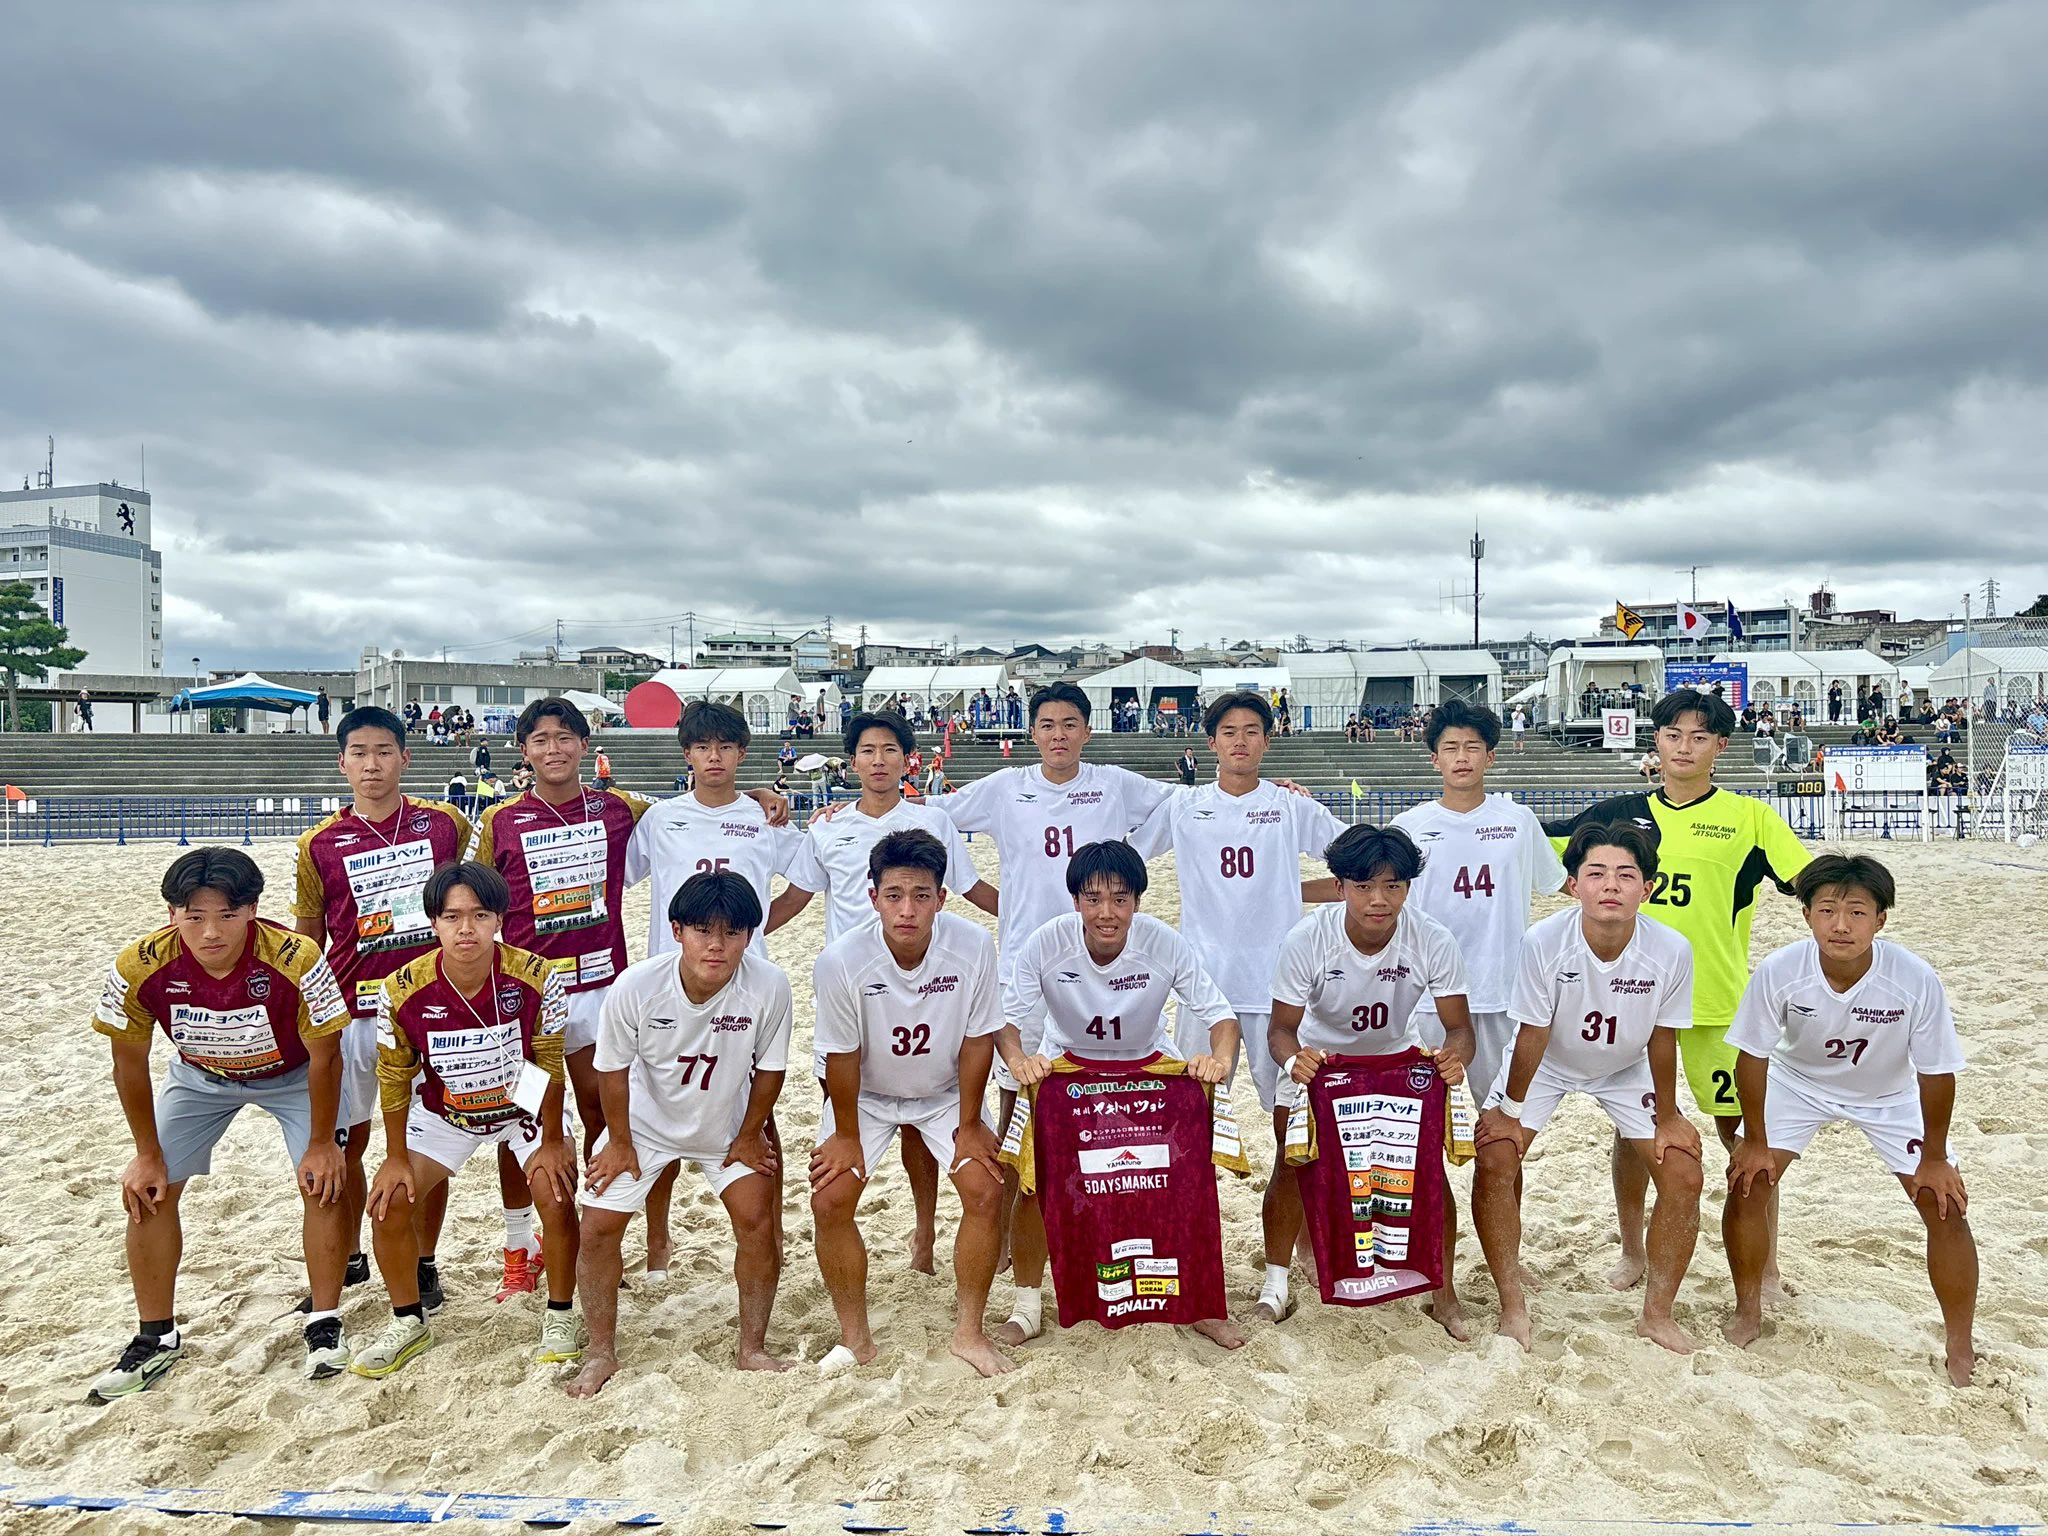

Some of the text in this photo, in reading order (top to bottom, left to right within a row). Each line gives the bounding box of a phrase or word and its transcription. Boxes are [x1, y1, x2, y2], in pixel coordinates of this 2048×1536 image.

[49, 508, 100, 533] HOTEL
[1855, 764, 1863, 776] 0
[1855, 778, 1863, 789] 0
[1070, 797, 1101, 805] JITSUGYO
[514, 815, 538, 825] PENALTY
[1690, 822, 1737, 834] ASAHIKAWA
[723, 830, 756, 839] JITSUGYO
[1475, 825, 1517, 835] ASAHIKAWA
[1480, 833, 1515, 841] JITSUGYO
[1693, 830, 1731, 840] JITSUGYO
[334, 837, 361, 848] PENALTY
[1044, 826, 1074, 858] 81
[349, 845, 429, 871] 旭川トヨペット
[1220, 846, 1255, 879] 80
[1453, 864, 1495, 899] 44
[1649, 872, 1692, 907] 25
[284, 938, 303, 967] PENALTY
[1108, 973, 1150, 986] ASAHIKAWA
[1112, 981, 1147, 991] JITSUGYO
[1609, 978, 1656, 988] ASAHIKAWA
[1612, 986, 1651, 995] JITSUGYO
[175, 1008, 264, 1024] 旭川トヨペット
[1351, 1002, 1389, 1032] 30
[1851, 1007, 1905, 1018] ASAHIKAWA
[1856, 1015, 1900, 1024] JITSUGYO
[1086, 1015, 1122, 1041] 41
[1581, 1010, 1617, 1045] 31
[891, 1023, 930, 1056] 32
[1824, 1038, 1869, 1066] 27
[677, 1054, 718, 1091] 77
[1084, 1079, 1167, 1095] 旭川しんきん
[1324, 1077, 1352, 1088] PENALTY
[1711, 1070, 1741, 1104] 2
[1338, 1100, 1419, 1116] 旭川トヨペット
[1084, 1174, 1168, 1195] 5DAYSMARKET
[1107, 1298, 1167, 1317] PENALTY
